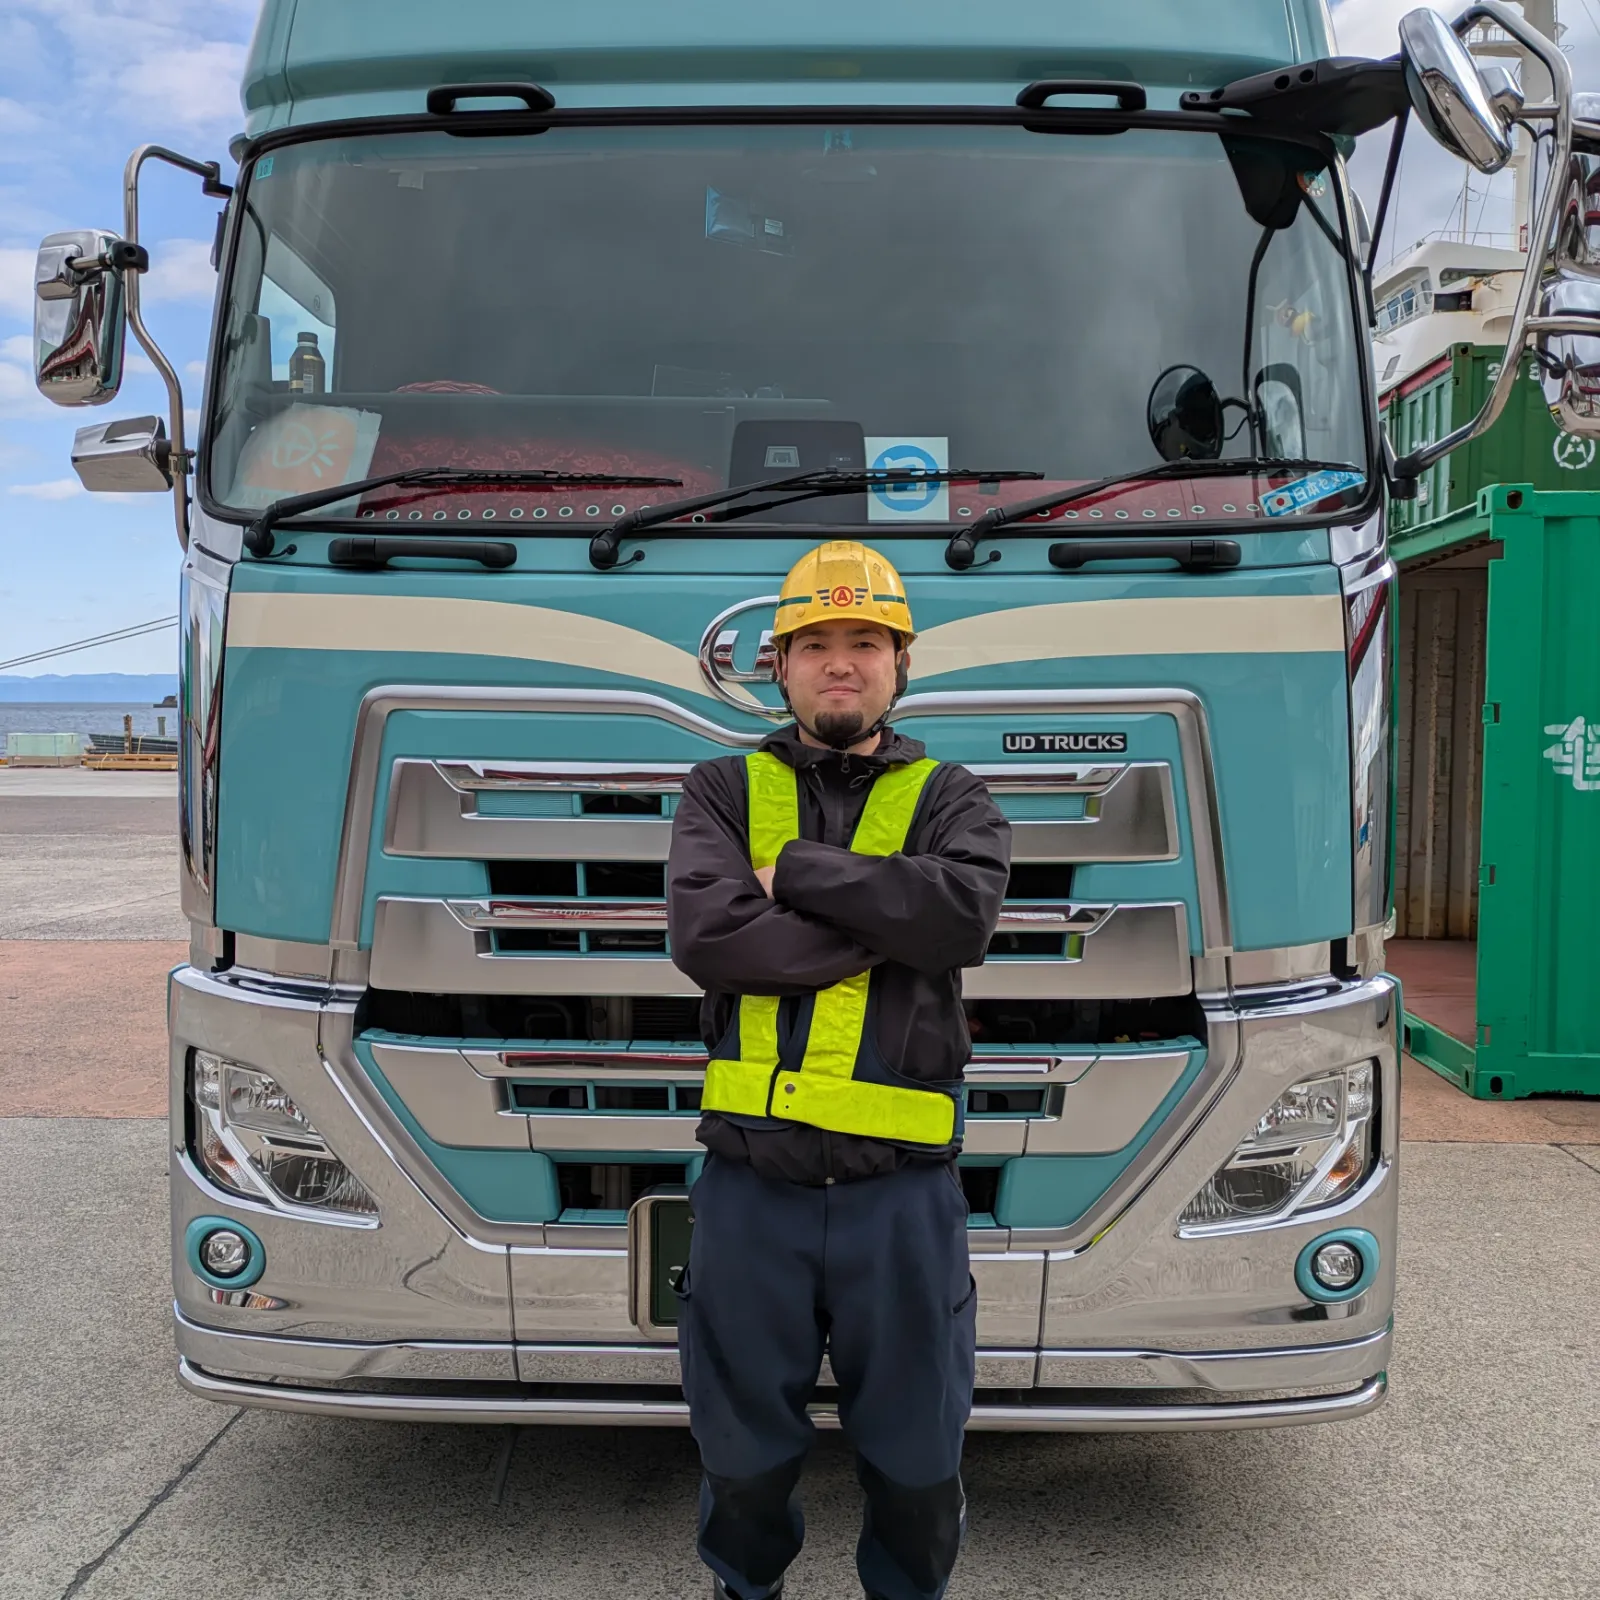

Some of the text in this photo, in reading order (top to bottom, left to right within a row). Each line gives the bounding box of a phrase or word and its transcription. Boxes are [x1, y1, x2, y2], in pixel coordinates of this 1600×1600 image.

[836, 589, 849, 602] A
[713, 629, 777, 683] U
[1005, 735, 1125, 750] UD TRUCKS
